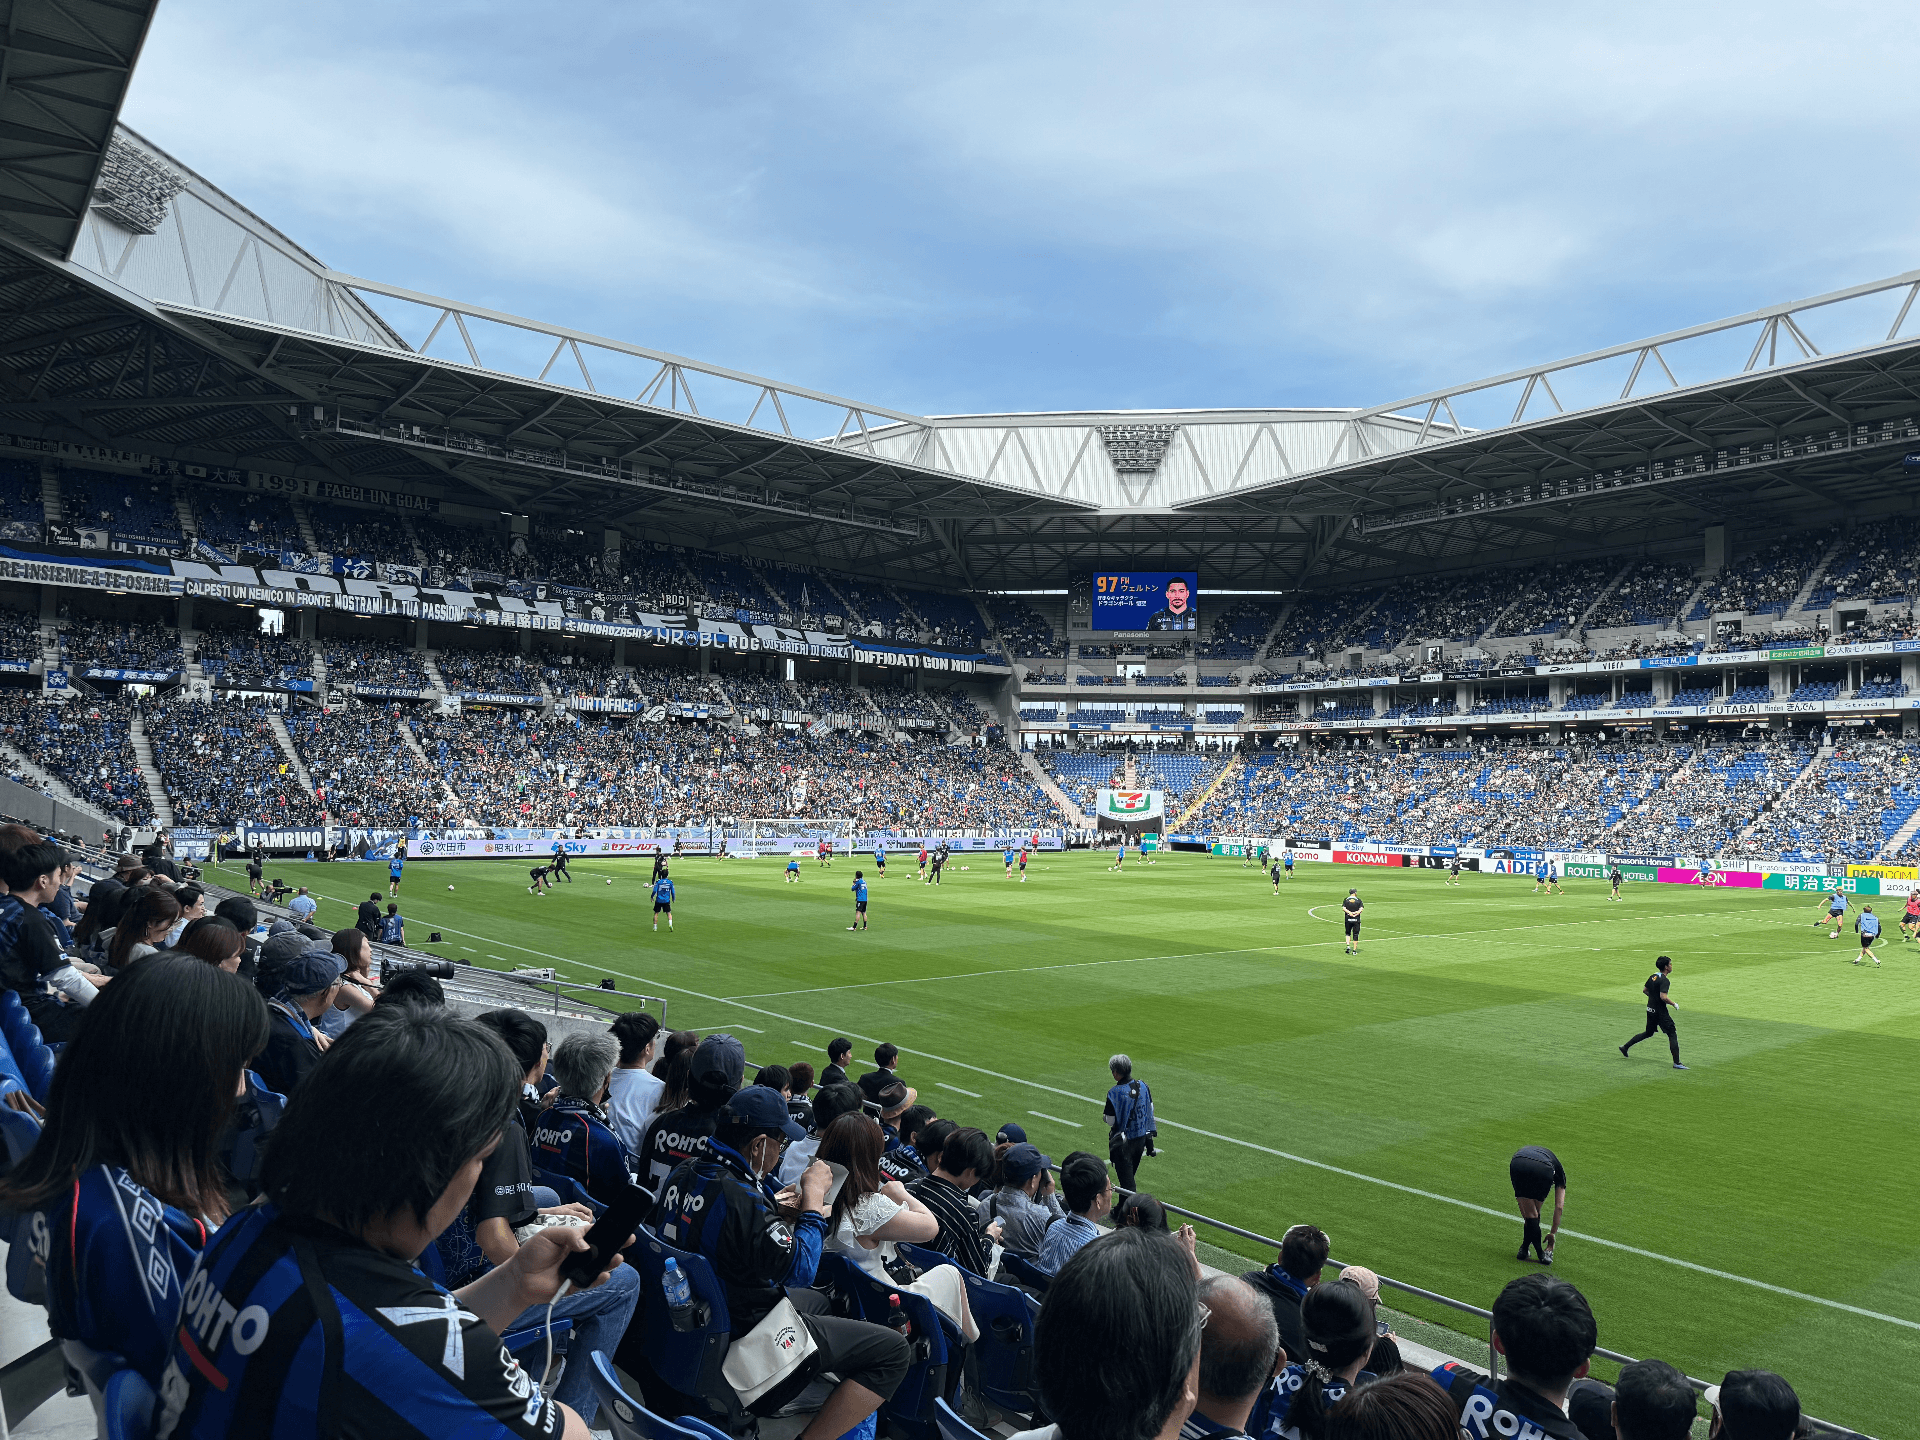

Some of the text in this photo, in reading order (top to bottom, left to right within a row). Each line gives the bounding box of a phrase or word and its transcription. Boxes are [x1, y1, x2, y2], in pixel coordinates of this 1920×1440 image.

[210, 467, 242, 484] 大阪
[256, 473, 310, 495] 1991
[324, 483, 431, 511] FACCI UN GOAL
[111, 541, 182, 557] ULTRAS
[24, 562, 89, 585] INSIEME
[90, 569, 101, 586] A
[104, 571, 122, 588] TE
[125, 574, 171, 593] OSAKA
[1097, 576, 1130, 593] 97 FW
[1120, 584, 1159, 592] ウェルトン
[186, 581, 231, 599] CALPESTI
[232, 585, 247, 599] UN
[248, 587, 284, 603] NEMICO
[285, 591, 295, 604] IN
[385, 598, 399, 615] LA
[401, 600, 419, 618] TUA
[422, 601, 468, 622] PASSIONE
[810, 644, 820, 656] DI
[820, 645, 850, 659] OSAKA
[1837, 645, 1892, 654] 大阪モノレール
[1500, 669, 1524, 677] LUMIX
[476, 693, 524, 704] GAMBINO
[1708, 704, 1756, 716] FUTABA
[1786, 702, 1817, 711] きんでん
[247, 830, 323, 848] GAMBINO
[858, 839, 877, 847] SHIP
[435, 841, 466, 852] 吹田市
[494, 843, 534, 853] 昭和化工
[564, 842, 588, 854] Sky
[1351, 844, 1365, 852] Sky
[1281, 849, 1319, 860] dcomo
[1346, 852, 1388, 864] KONAMI
[1561, 853, 1598, 864] 昭和化工
[1609, 856, 1673, 867] Panasonic Homes
[1722, 860, 1745, 868] SHIP
[1567, 866, 1601, 878] ROUTE
[1622, 871, 1655, 881] HOTELS
[1754, 863, 1787, 872] Panasonic
[1789, 865, 1821, 874] SPORTS
[1852, 869, 1884, 878] DAZN
[1784, 875, 1857, 893] 明治安田
[531, 1126, 572, 1148] ROHTO
[654, 1129, 709, 1153] ROHTO
[780, 1334, 796, 1350] VAN
